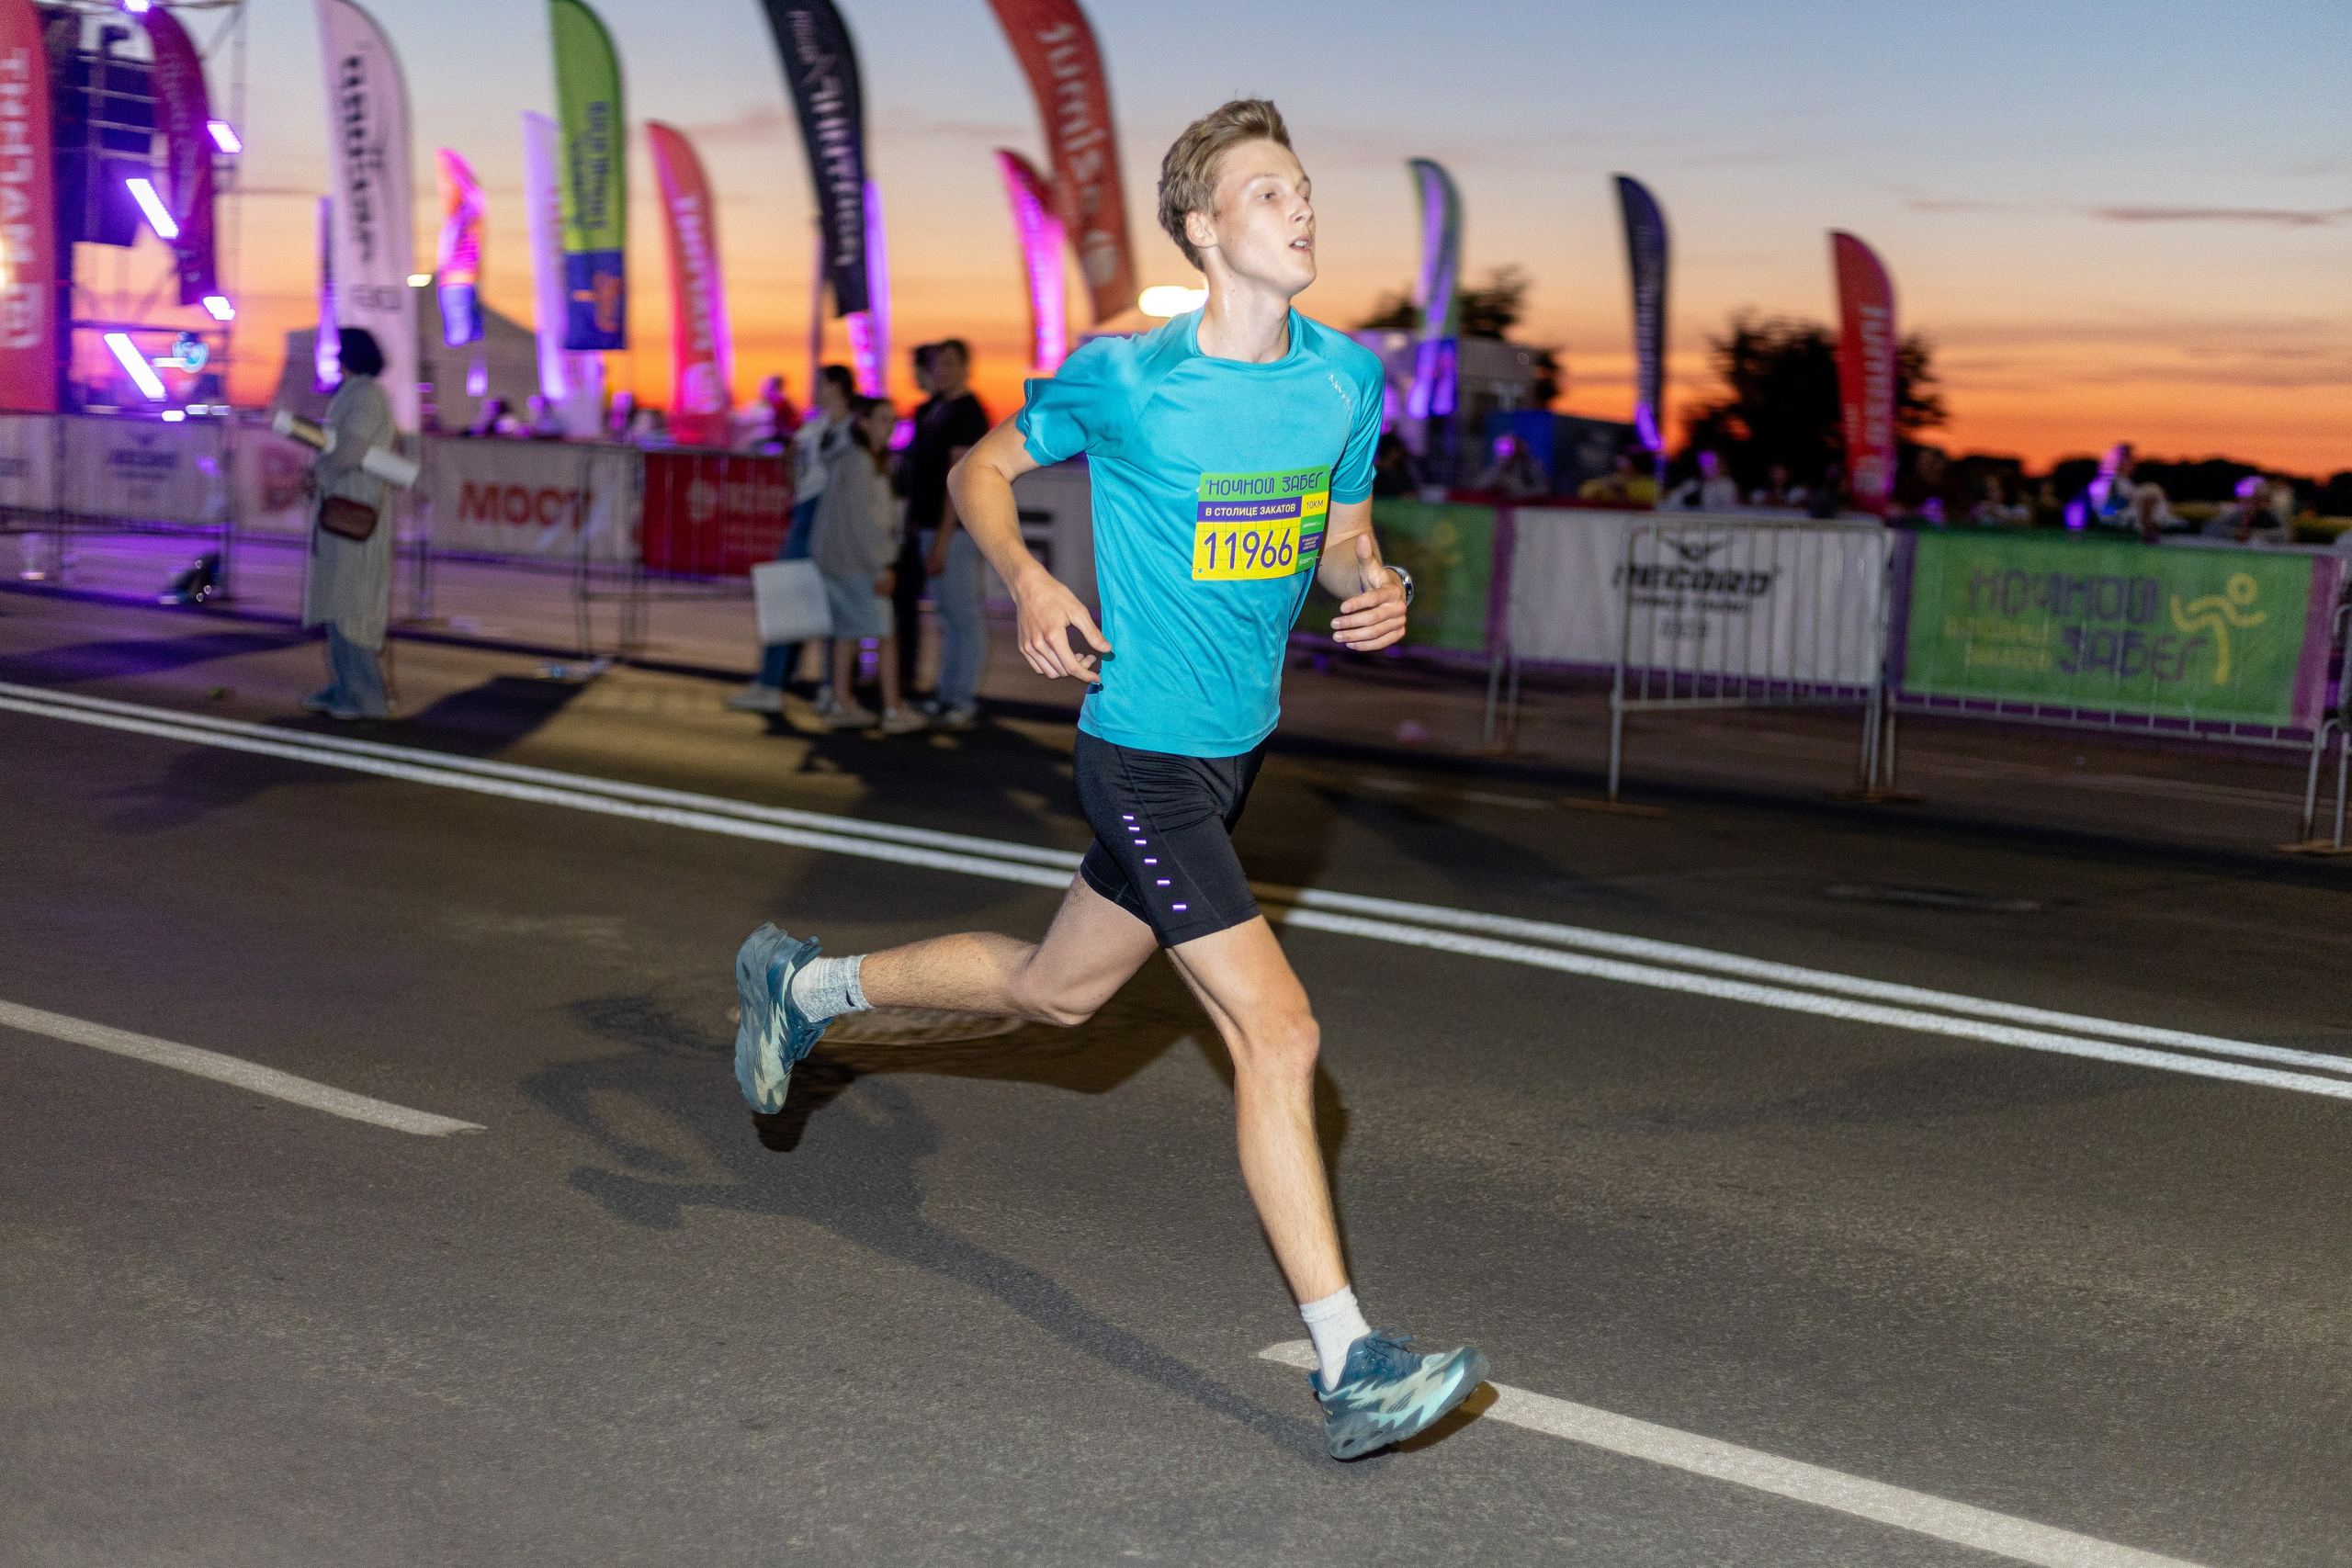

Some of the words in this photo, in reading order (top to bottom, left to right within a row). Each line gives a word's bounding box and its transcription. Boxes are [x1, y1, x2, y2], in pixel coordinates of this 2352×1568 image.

[1208, 477, 1275, 496] НОЧНОЙ
[1282, 471, 1324, 493] ЗАБЕГ
[1205, 507, 1212, 517] В
[1215, 506, 1258, 518] СТОЛИЦЕ
[1260, 503, 1296, 515] ЗАКАТОВ
[1204, 527, 1293, 570] 11966
